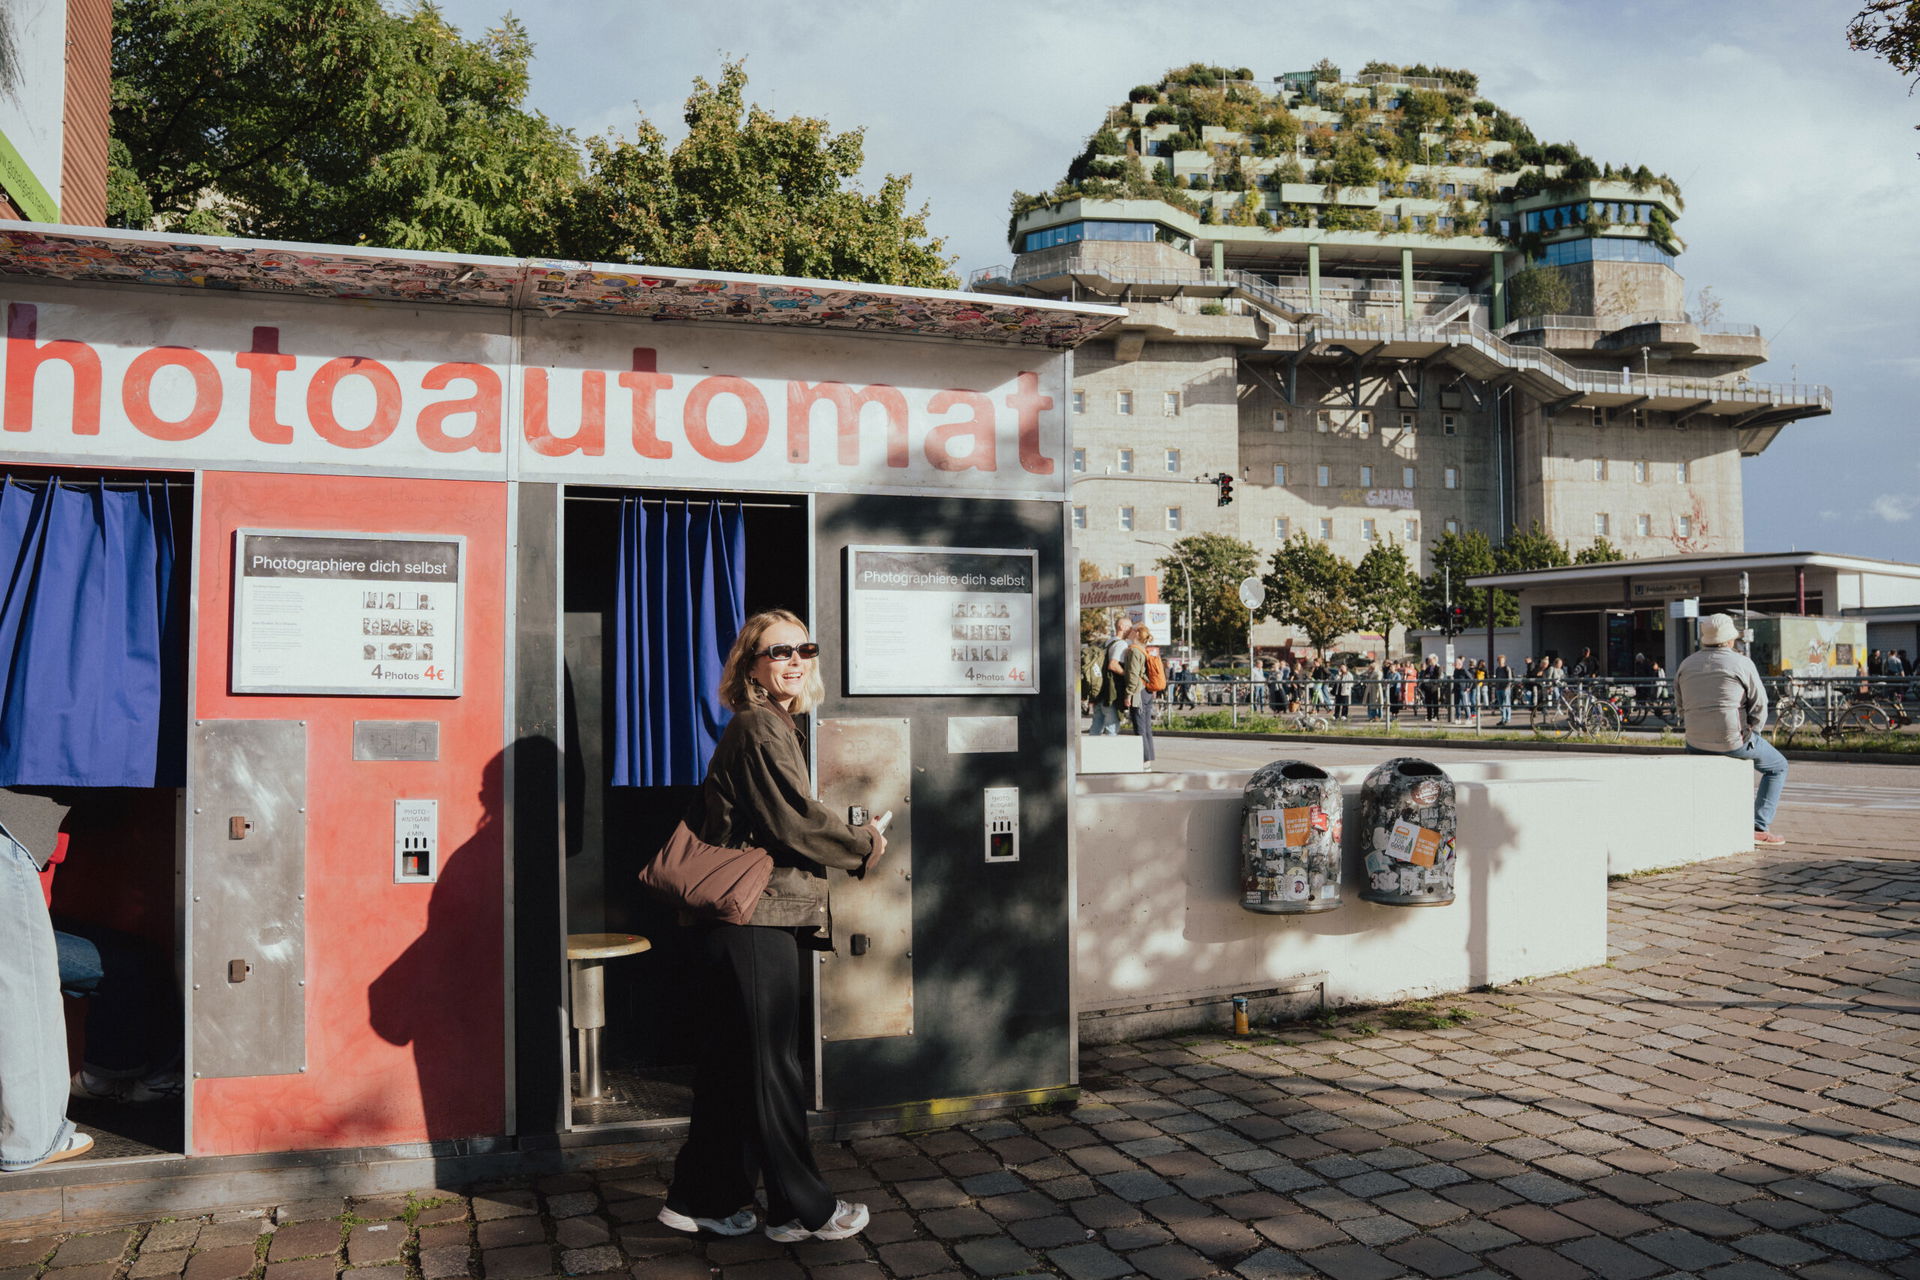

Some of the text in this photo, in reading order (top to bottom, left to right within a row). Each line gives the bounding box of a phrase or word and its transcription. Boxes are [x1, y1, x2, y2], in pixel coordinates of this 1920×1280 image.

[253, 556, 447, 574] Photographiere dich selbst
[864, 571, 1025, 587] Photographiere dich selbst
[1091, 579, 1130, 591] Herzlich
[1080, 591, 1142, 606] Willkommen
[371, 664, 444, 681] 4 Photos 4€
[965, 667, 1025, 681] 4 Photos 4€
